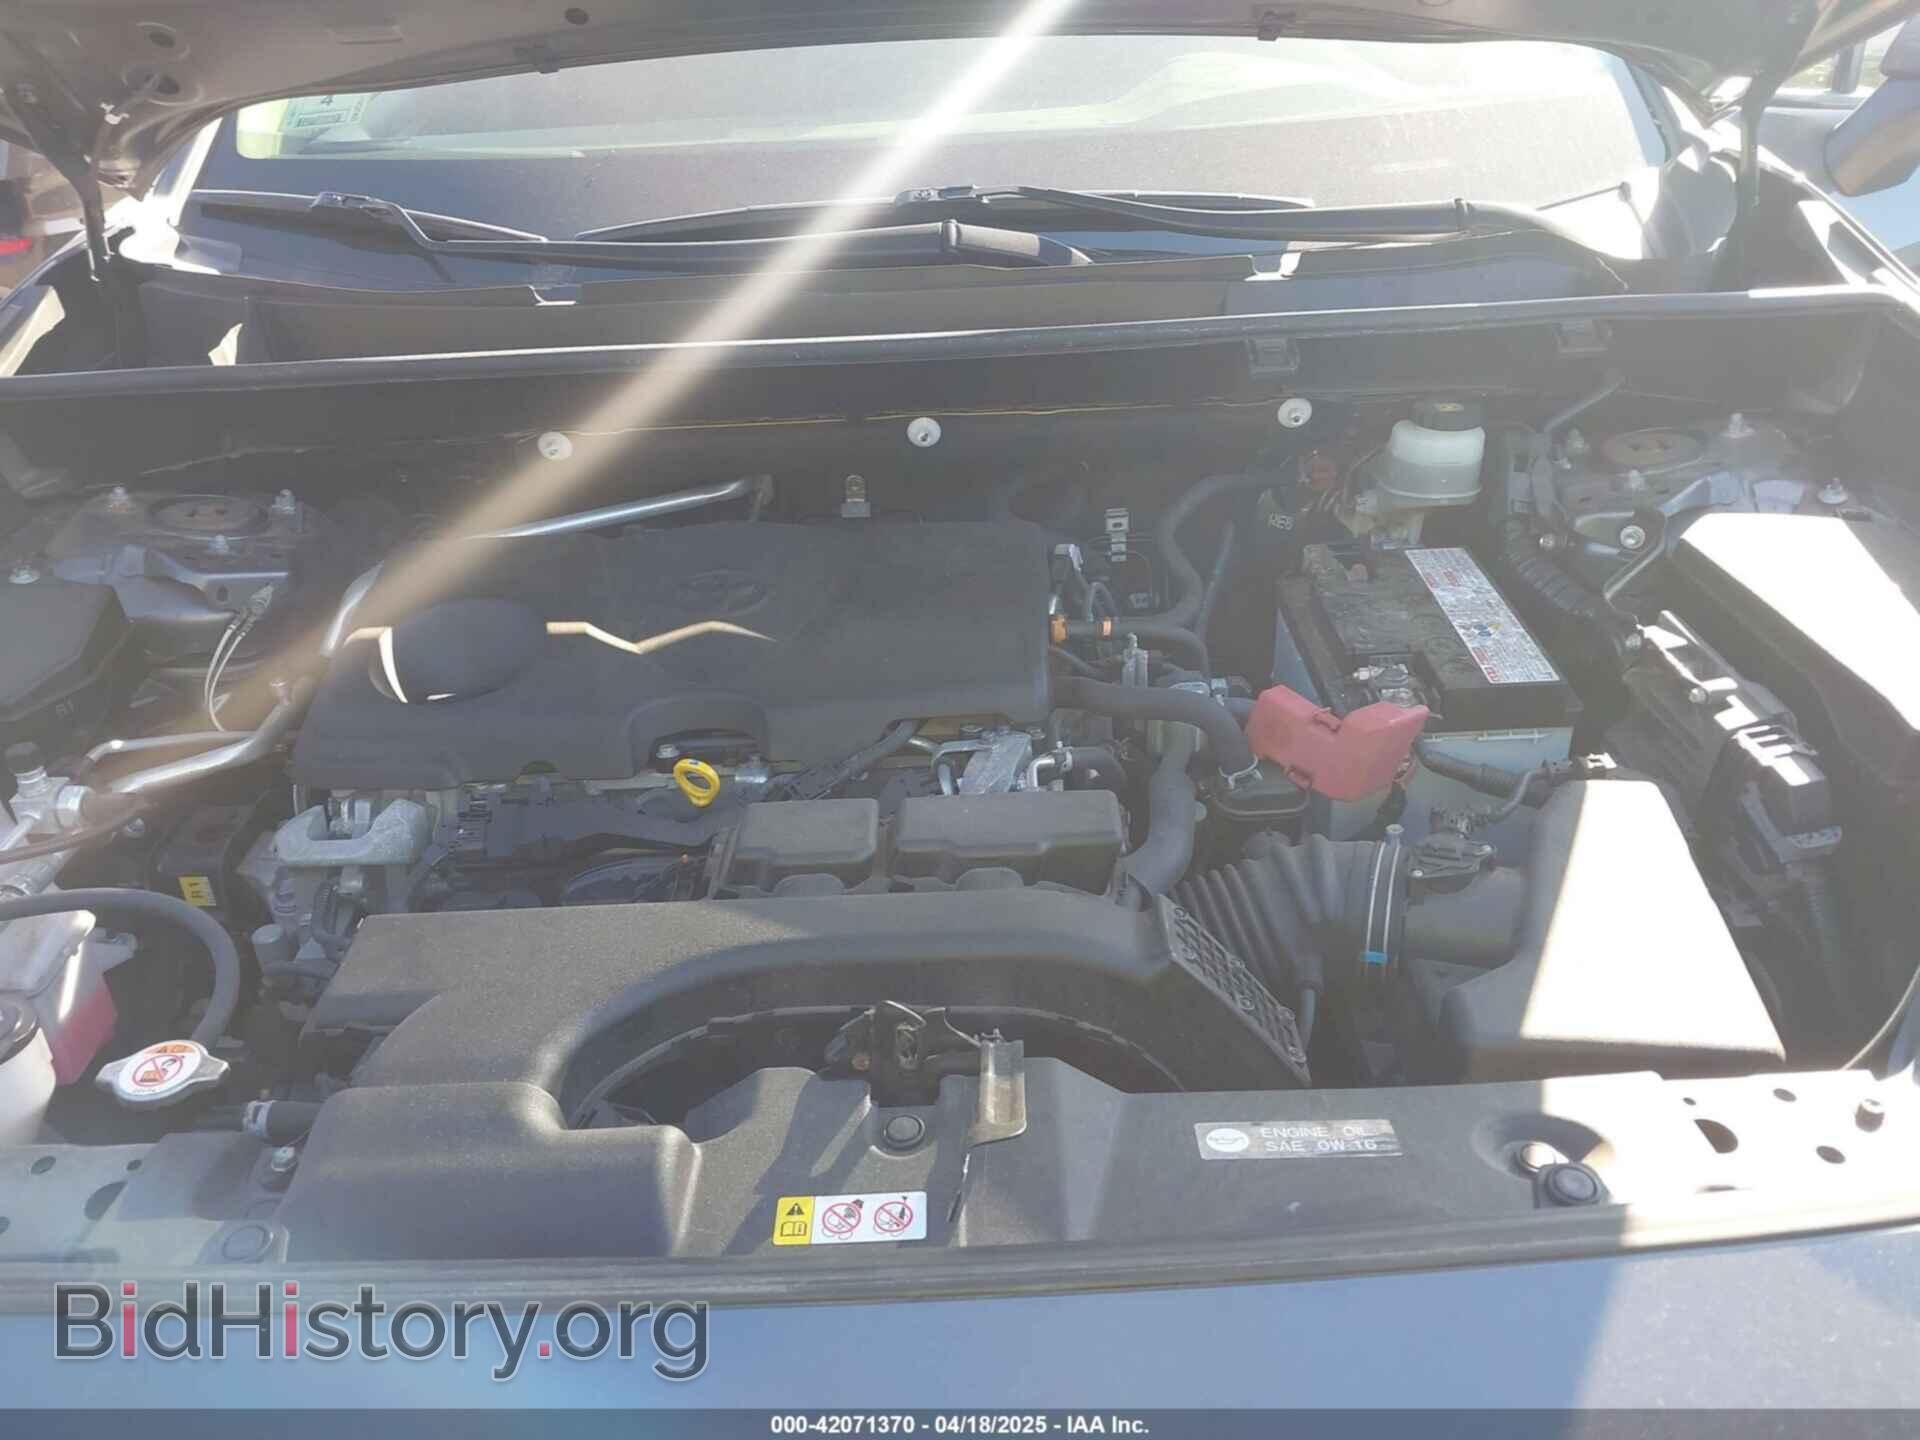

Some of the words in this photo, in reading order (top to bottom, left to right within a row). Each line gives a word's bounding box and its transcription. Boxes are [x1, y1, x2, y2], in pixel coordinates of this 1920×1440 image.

[1260, 1126, 1329, 1138] ENGINE
[1343, 1125, 1372, 1136] OIL
[1265, 1140, 1306, 1152] SAE
